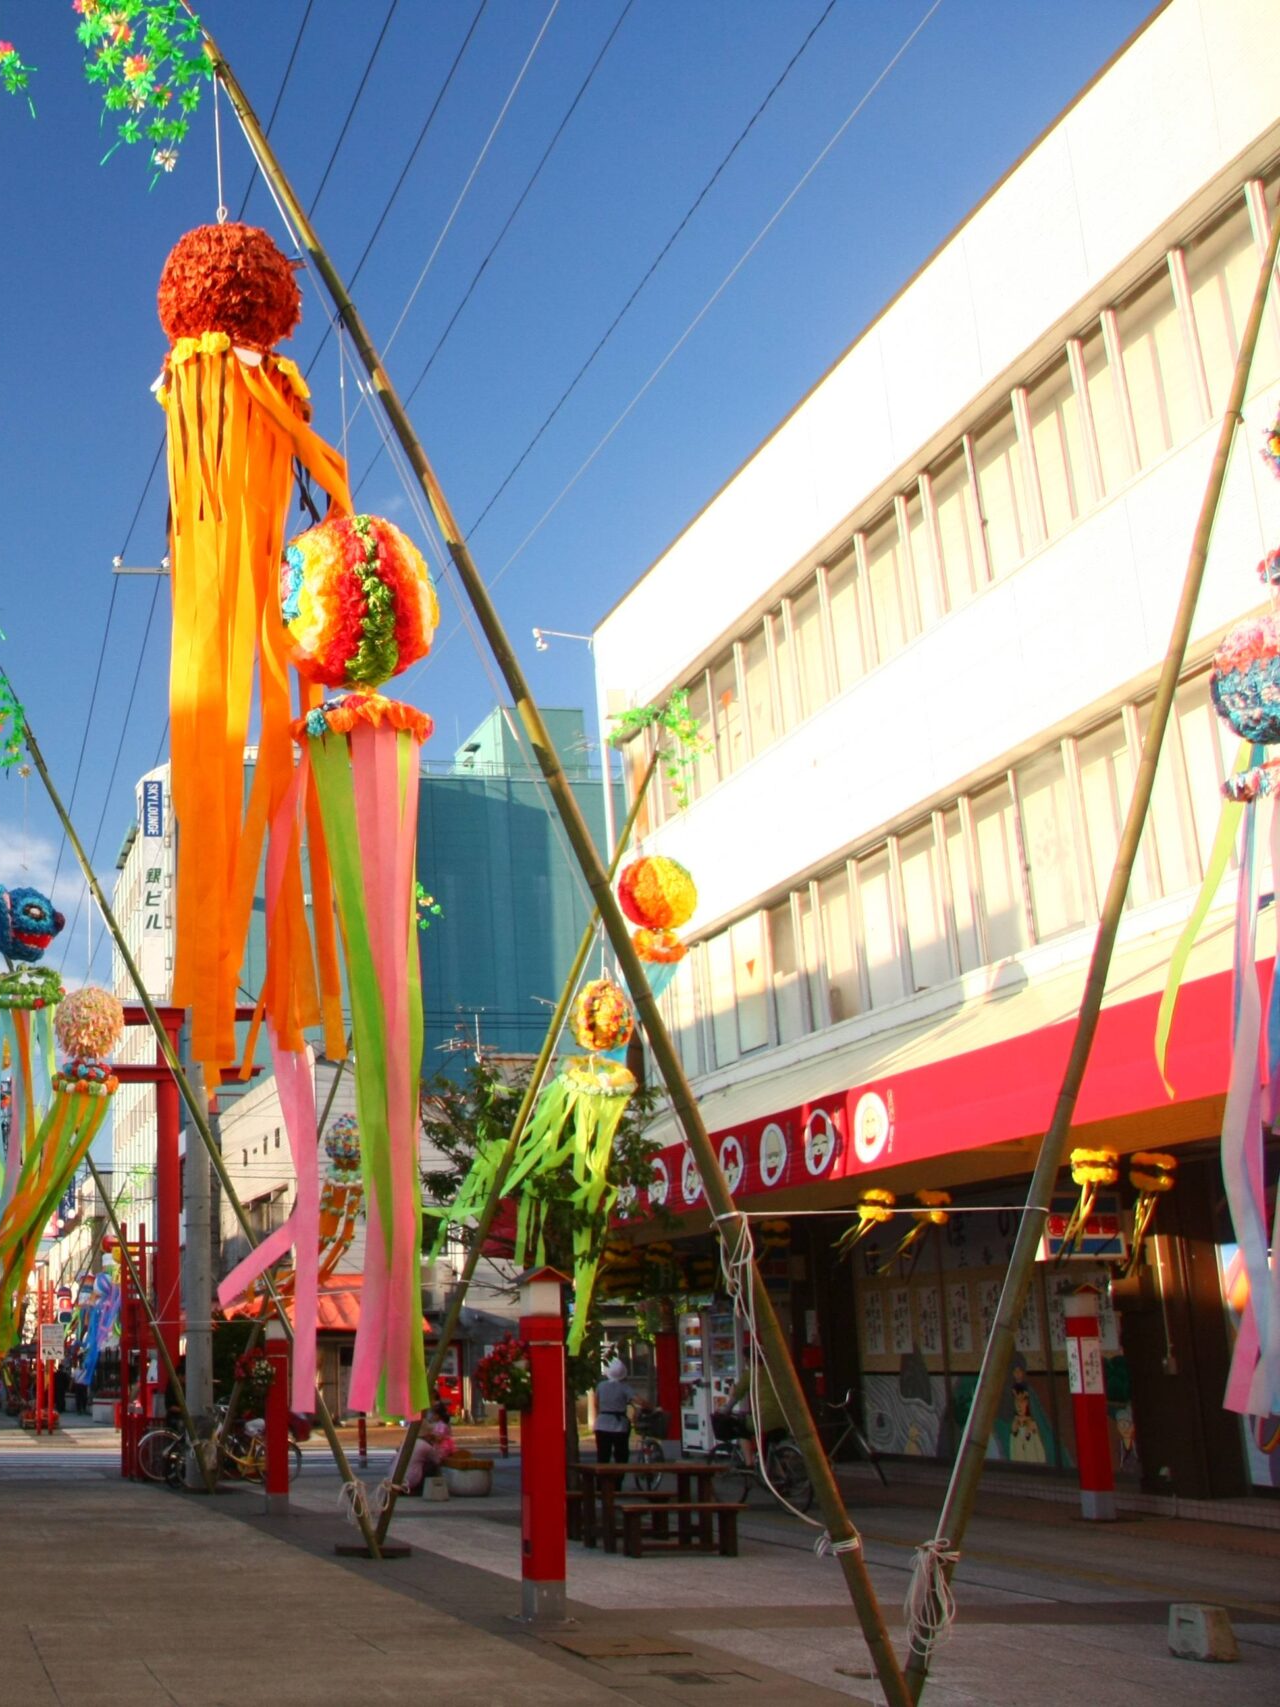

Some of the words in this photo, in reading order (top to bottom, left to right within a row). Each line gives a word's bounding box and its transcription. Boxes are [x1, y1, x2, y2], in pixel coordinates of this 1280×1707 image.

[146, 783, 159, 801] SKY
[146, 801, 160, 836] LOUNGE
[144, 867, 163, 930] 銀ビル
